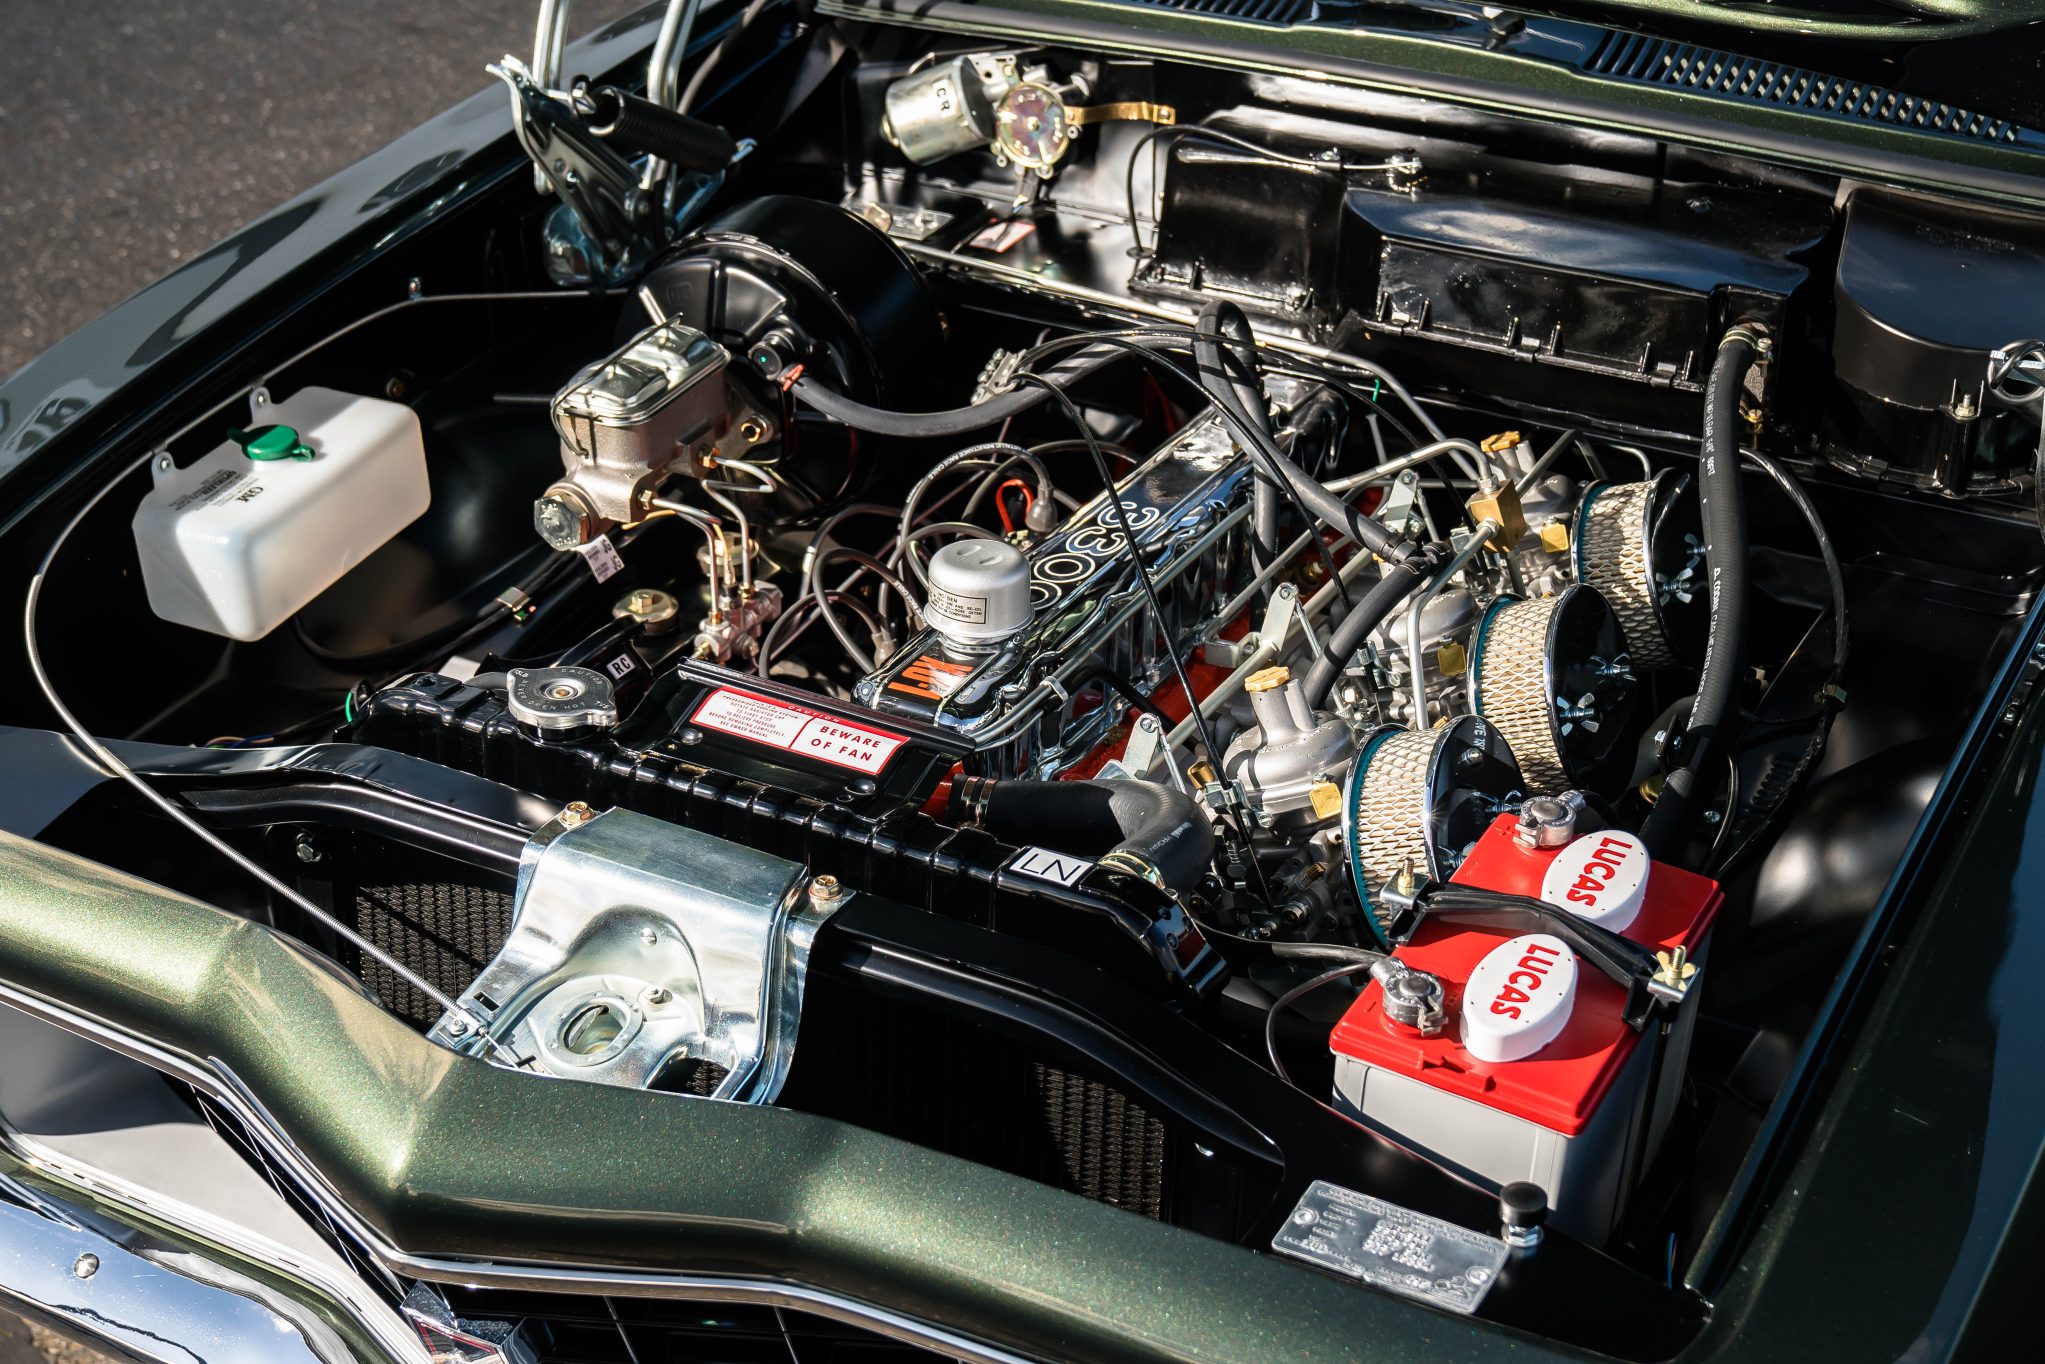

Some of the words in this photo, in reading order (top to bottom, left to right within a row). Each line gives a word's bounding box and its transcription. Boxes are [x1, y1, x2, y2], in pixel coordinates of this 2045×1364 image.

[235, 486, 264, 502] GM
[611, 657, 631, 676] RC
[788, 705, 840, 723] CAUTION
[820, 726, 881, 748] BEWARE
[811, 738, 832, 750] OF
[839, 746, 872, 761] FAN
[1020, 853, 1082, 881] LN
[1566, 836, 1633, 907] LUCAS
[1489, 943, 1561, 1020] LUCAS
